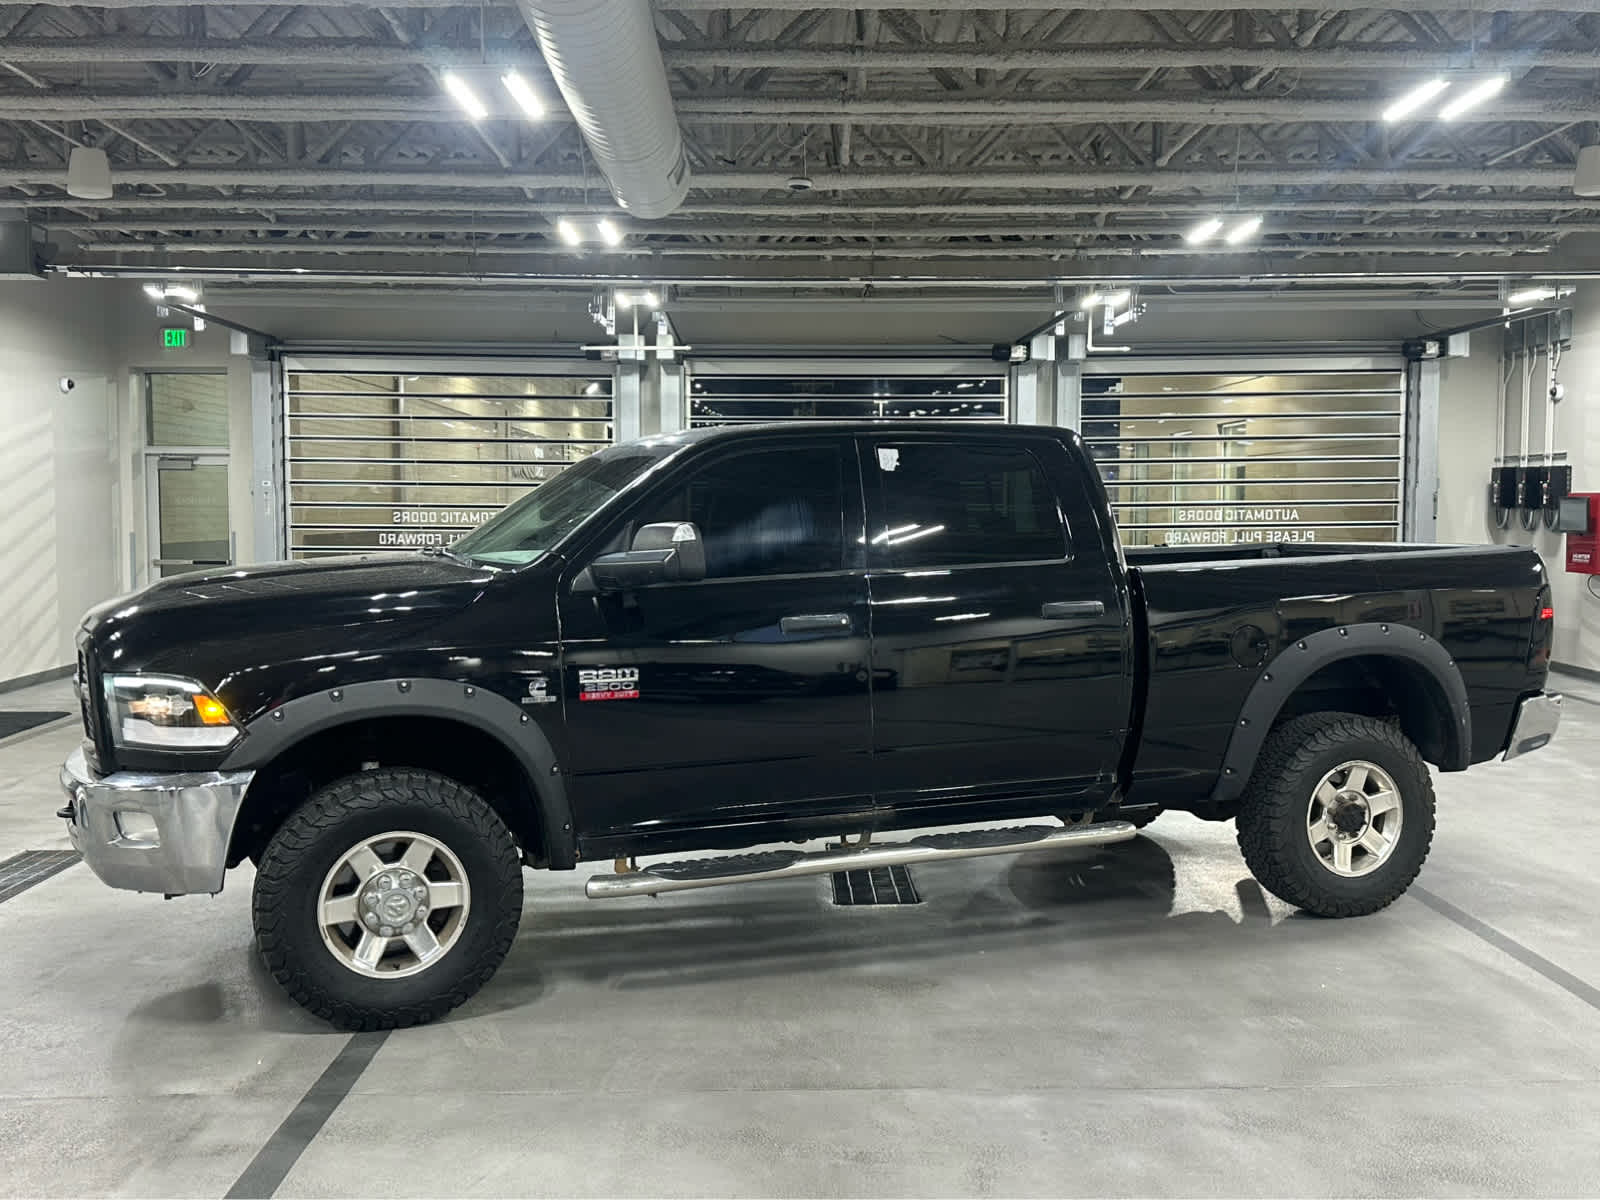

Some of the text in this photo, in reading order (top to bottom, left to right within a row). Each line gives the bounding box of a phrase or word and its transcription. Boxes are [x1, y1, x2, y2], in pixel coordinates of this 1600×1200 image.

[164, 329, 186, 347] EXIT
[579, 668, 639, 683] RAM
[584, 682, 634, 691] 2500
